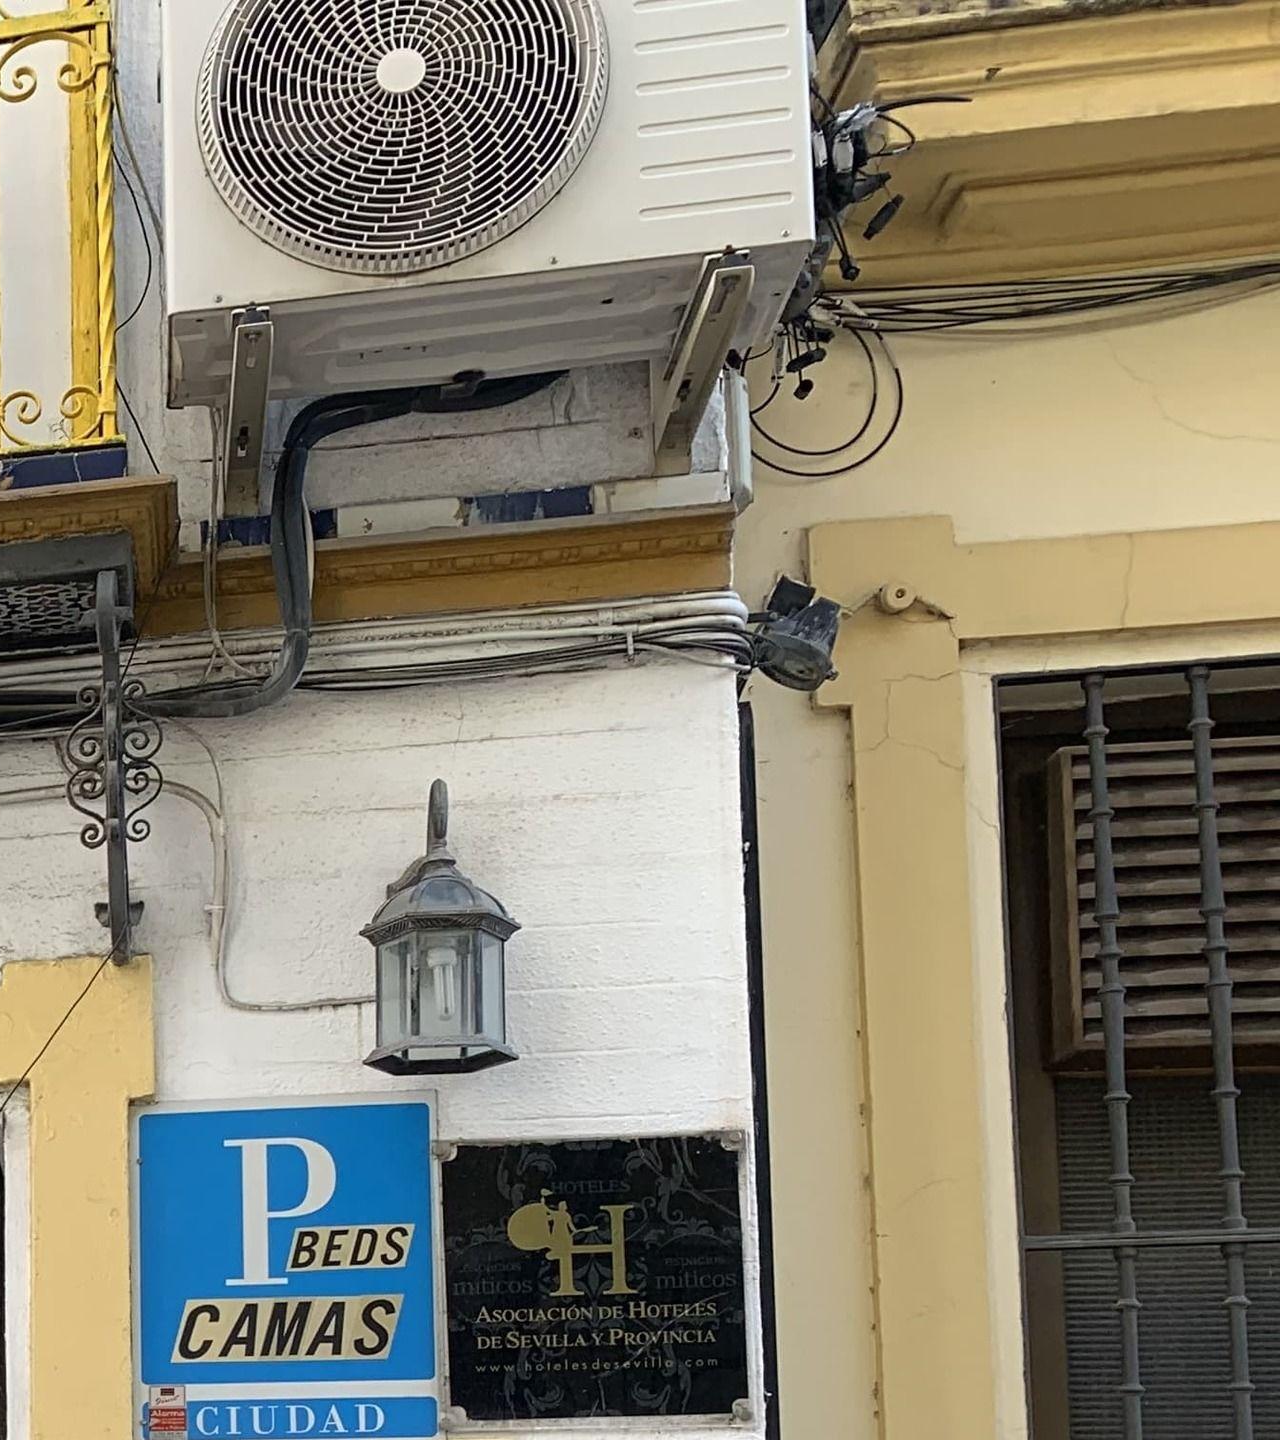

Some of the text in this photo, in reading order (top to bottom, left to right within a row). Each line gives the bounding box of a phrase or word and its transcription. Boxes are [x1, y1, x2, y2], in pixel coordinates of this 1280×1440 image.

[551, 1180, 631, 1194] HOTELES
[223, 1137, 336, 1286] P
[291, 1226, 409, 1269] BEDS
[475, 1300, 718, 1324] ASOCIACIÓN DE HOTELES
[178, 1299, 396, 1360] CAMAS
[477, 1335, 503, 1350] DE
[506, 1331, 586, 1350] SEVILLA
[609, 1329, 717, 1346] PROVINCIA
[196, 1404, 385, 1436] CIUDAD
